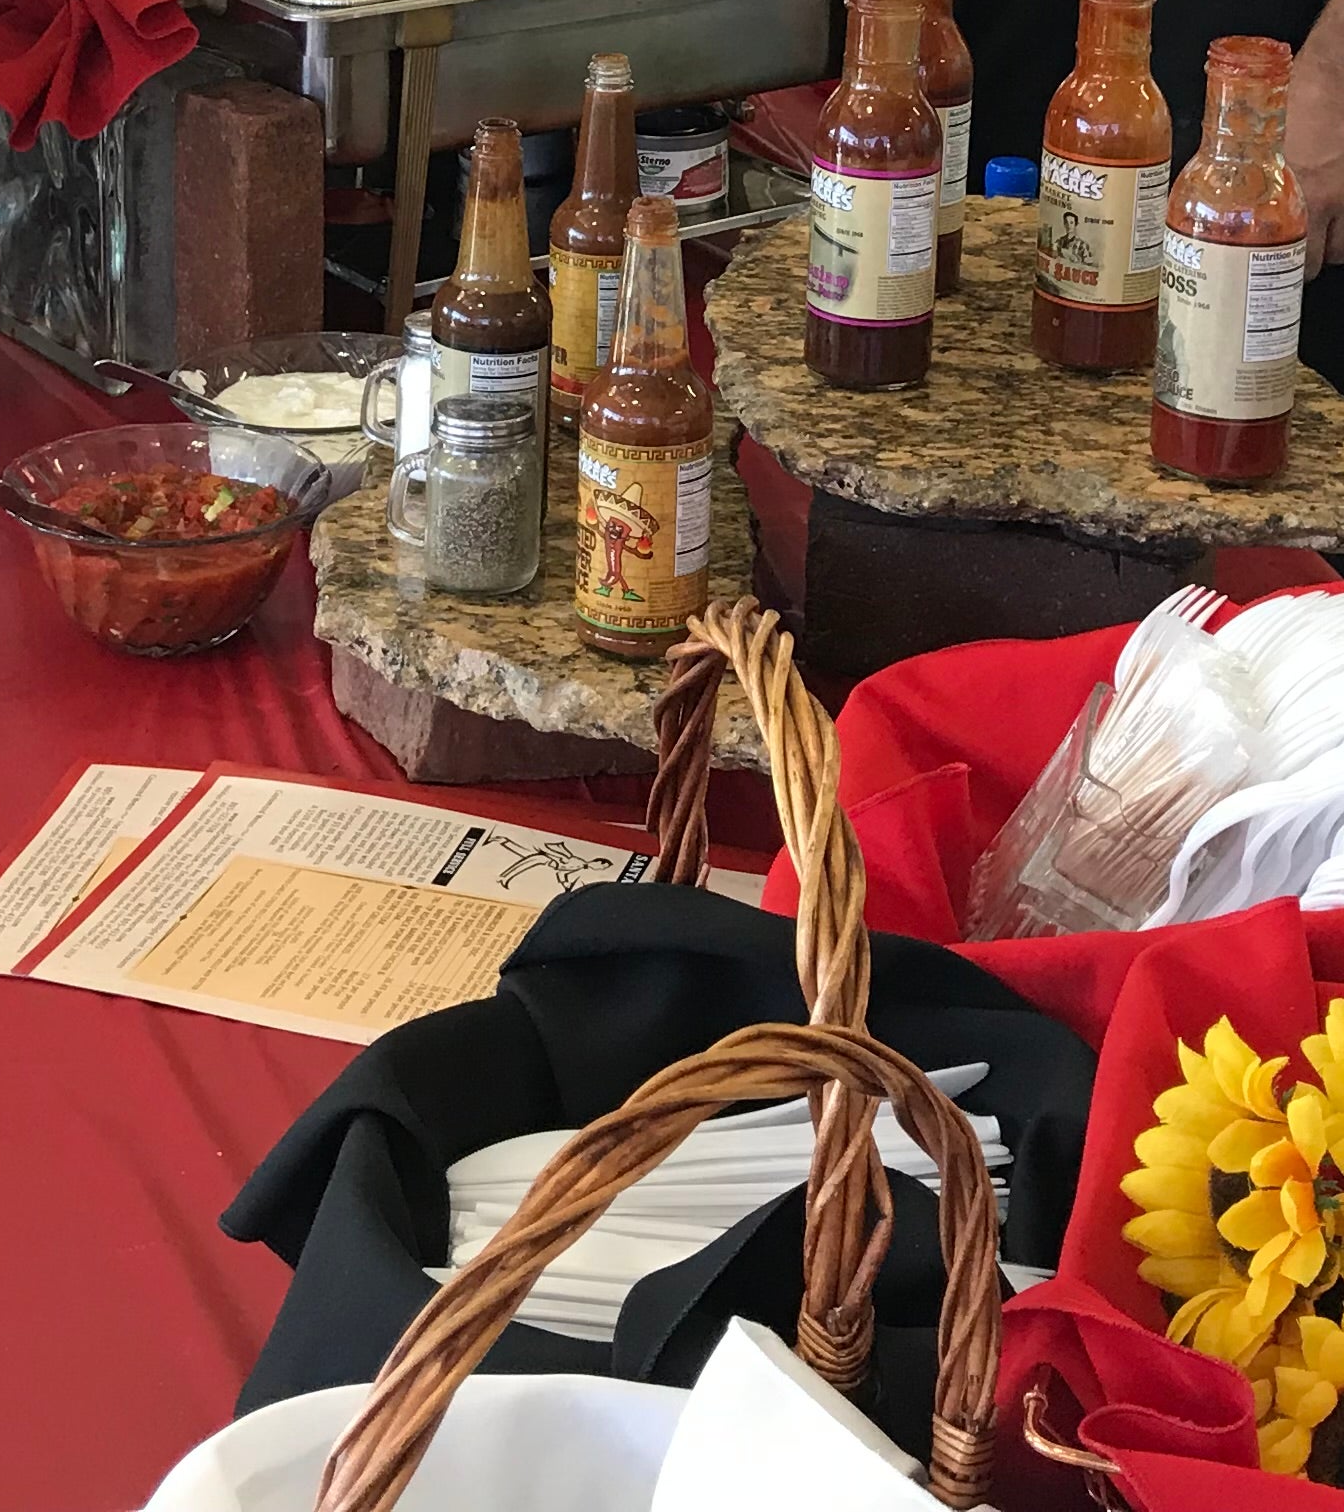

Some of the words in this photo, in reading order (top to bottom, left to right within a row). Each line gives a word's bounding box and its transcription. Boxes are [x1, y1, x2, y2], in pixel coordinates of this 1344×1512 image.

[640, 154, 671, 166] Sterno
[1051, 162, 1107, 200] ACRES
[1251, 250, 1291, 262] Nutrition
[1054, 262, 1099, 286] SAUCE
[1174, 263, 1207, 281] CATERING
[472, 357, 515, 366] Nutrition
[517, 355, 538, 365] Facts
[457, 837, 477, 851] FULL
[440, 851, 468, 874] SERVICE
